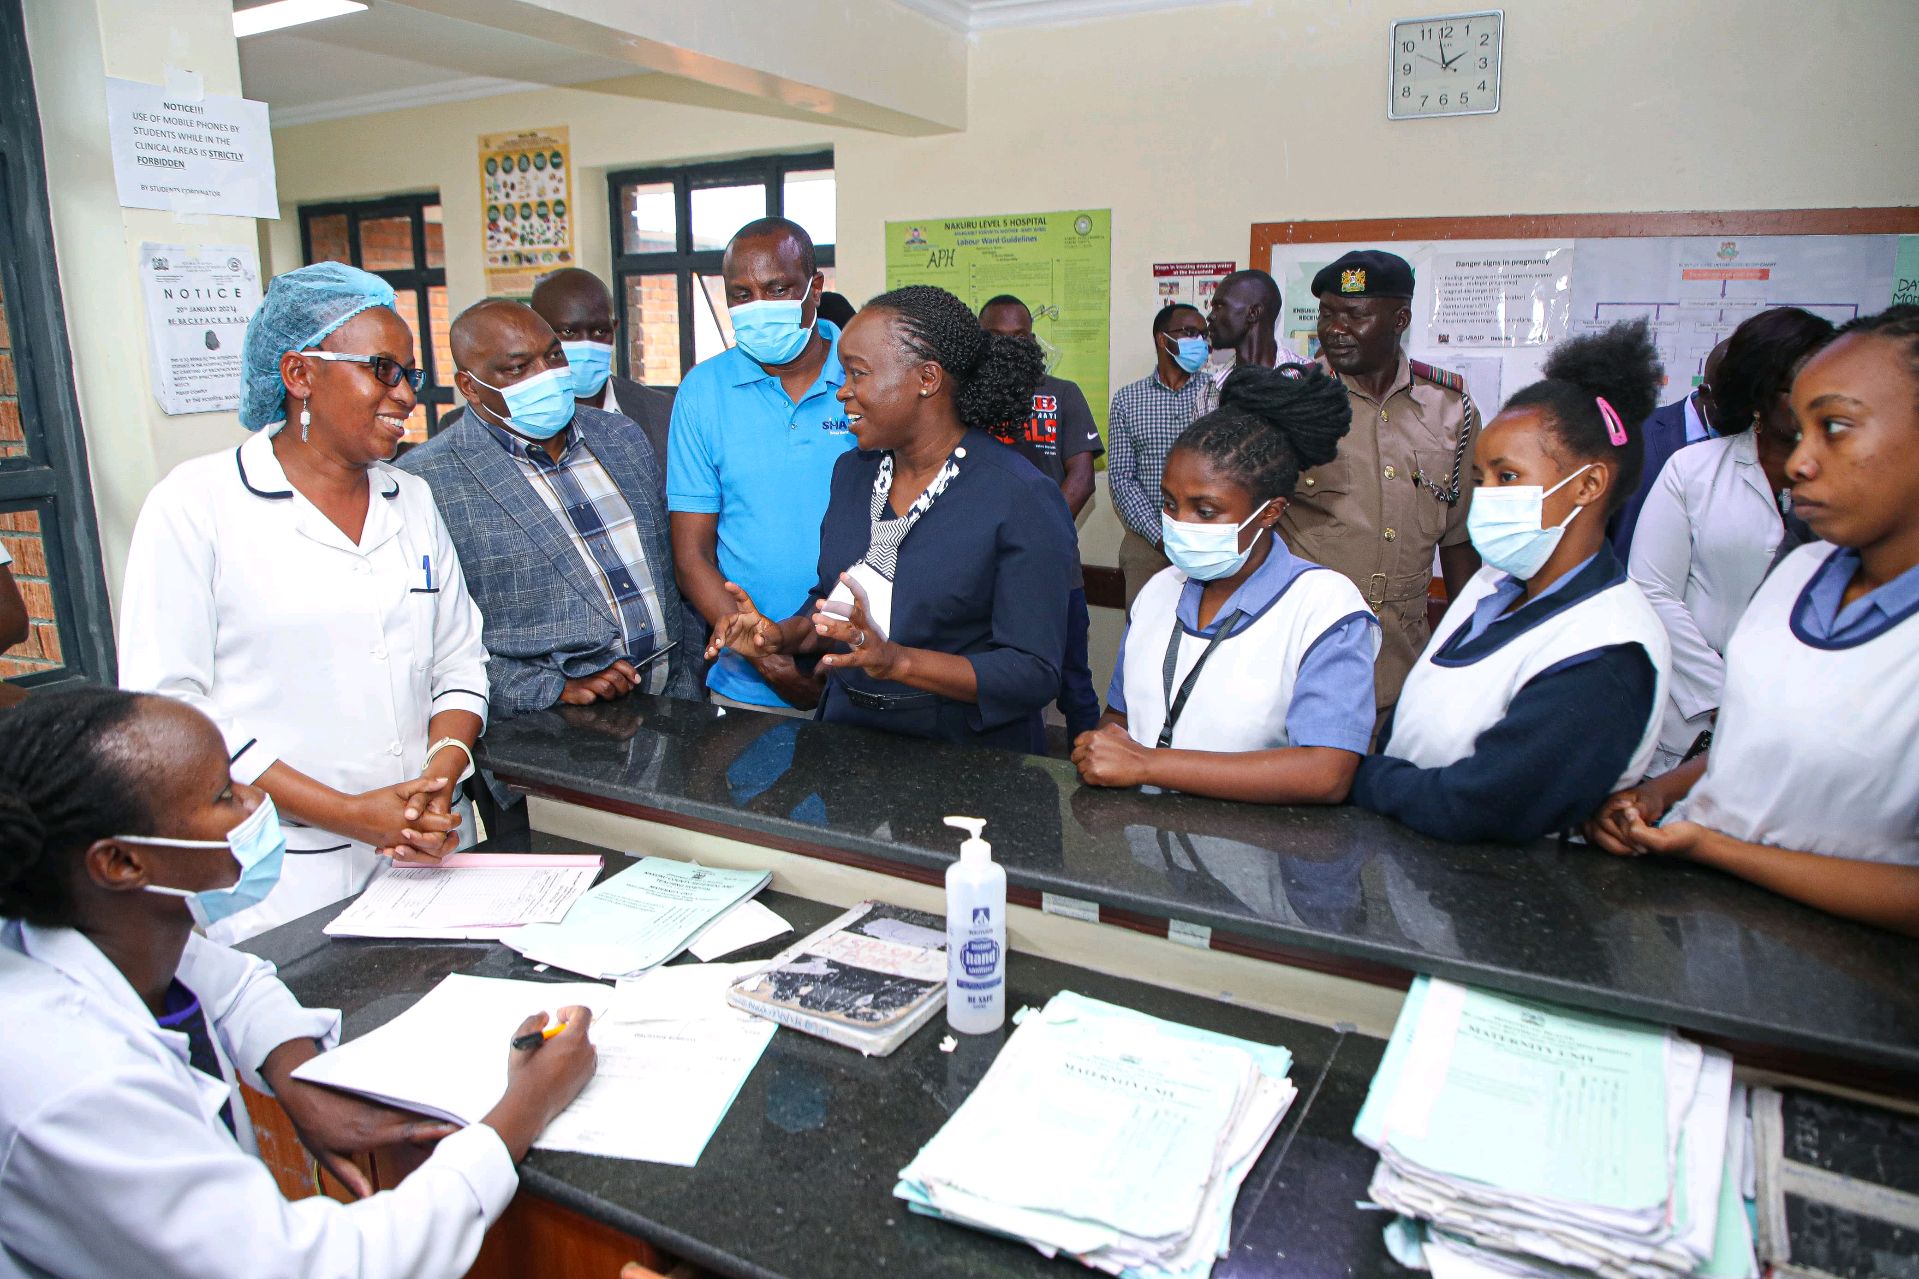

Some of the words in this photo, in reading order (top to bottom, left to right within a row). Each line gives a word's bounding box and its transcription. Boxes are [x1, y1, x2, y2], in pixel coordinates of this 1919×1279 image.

[1421, 28, 1432, 40] 11
[1438, 26, 1453, 39] 12
[1465, 24, 1470, 37] 1
[1480, 34, 1488, 46] 2
[1402, 41, 1414, 53] 10
[1478, 57, 1488, 69] 3
[1402, 64, 1412, 75] 9
[1402, 86, 1410, 98] 8
[1478, 80, 1486, 92] 4
[1420, 95, 1428, 107] 7
[1439, 94, 1448, 106] 6
[1460, 92, 1468, 104] 5
[164, 102, 204, 114] NOTICE!!!
[132, 112, 148, 122] USE
[149, 114, 161, 123] OF
[163, 116, 194, 127] MOBILE
[197, 120, 229, 132] PHONES
[230, 124, 240, 133] BY
[133, 127, 176, 139] STUDENTS
[178, 133, 204, 142] WHILE
[215, 137, 231, 145] THE
[135, 142, 171, 152] CLINICAL
[173, 146, 198, 156] AREAS
[208, 150, 244, 161] STRICTLY
[137, 156, 185, 169] FORBIDDEN
[944, 221, 977, 230] NAKURU
[979, 219, 1000, 227] LEVEL
[1011, 217, 1047, 226] HOSPITAL
[957, 238, 980, 246] Labour
[982, 237, 999, 245] Ward
[926, 248, 955, 269] APH
[1455, 260, 1482, 268] Danger
[1483, 259, 1501, 268] signs
[1512, 258, 1550, 267] pregnancy
[1898, 279, 1919, 291] DA
[164, 288, 241, 299] NOTICE
[966, 950, 995, 965] hand
